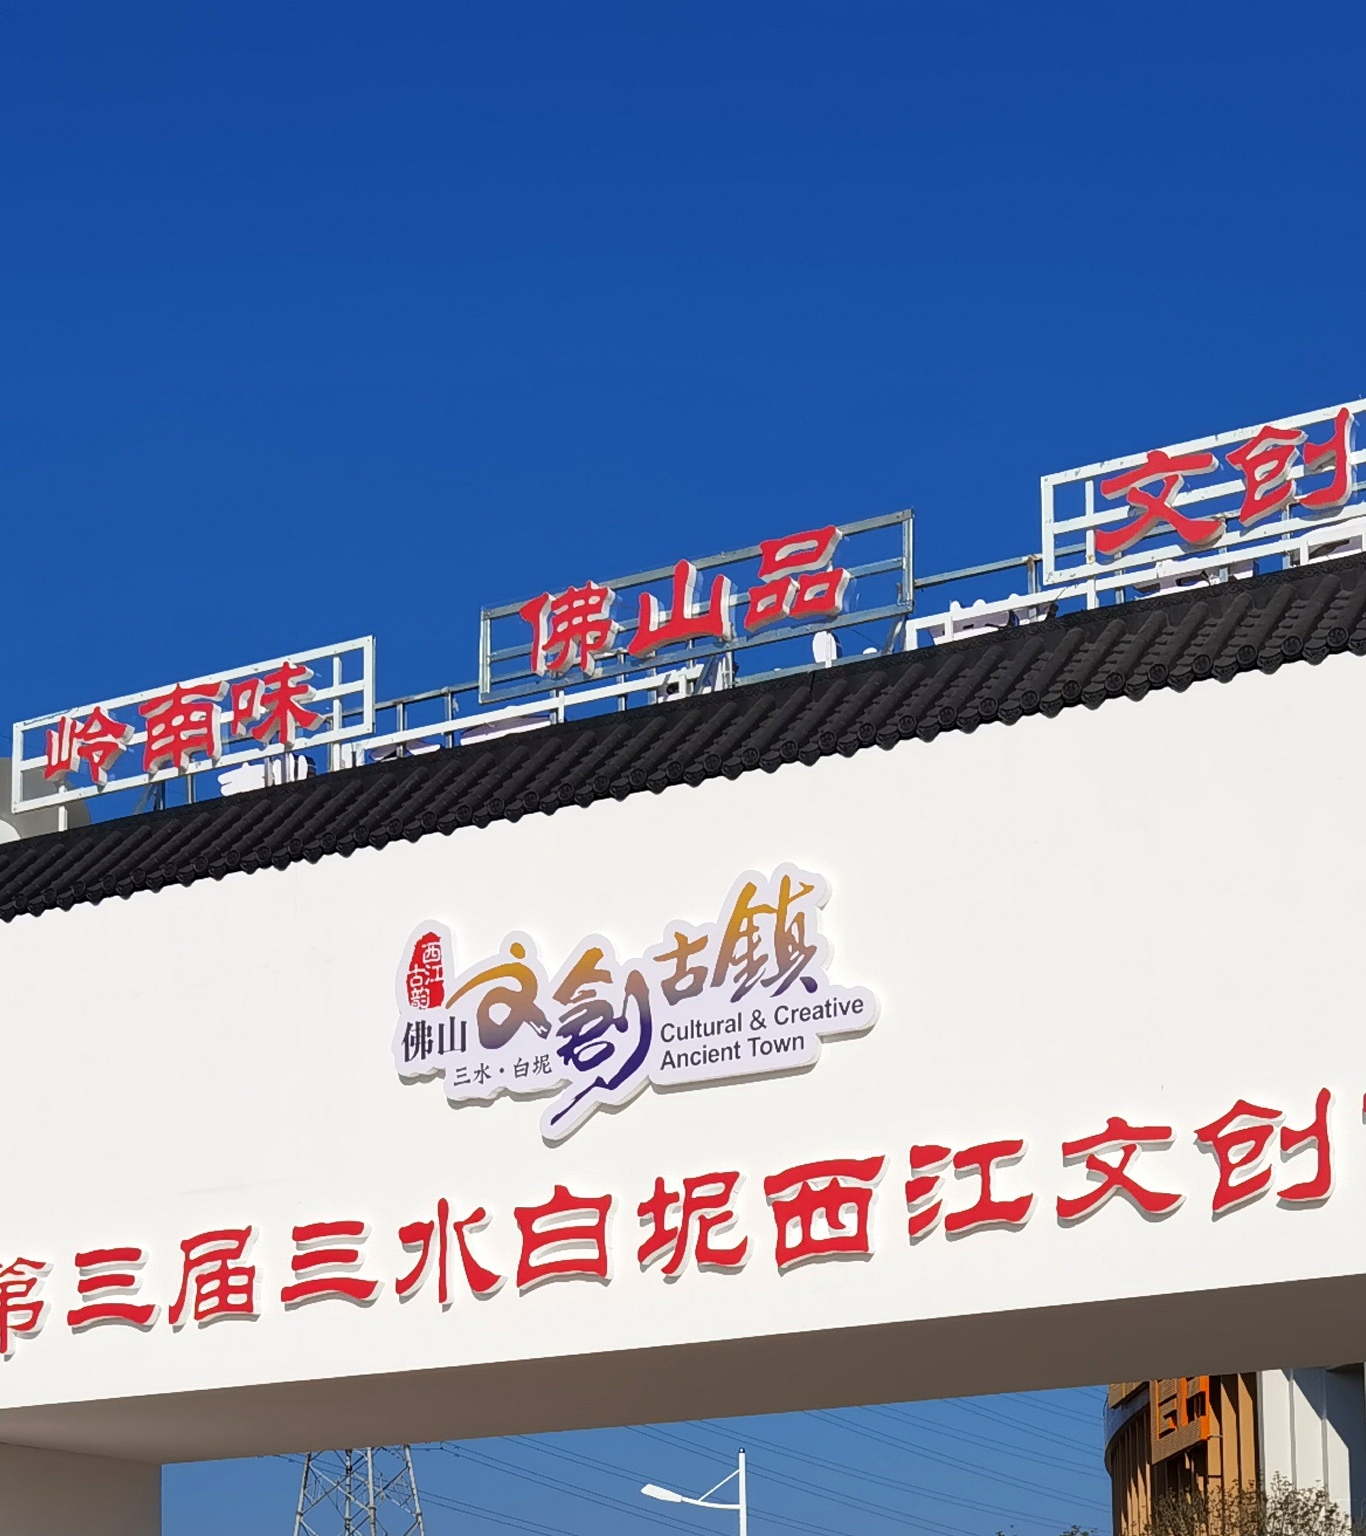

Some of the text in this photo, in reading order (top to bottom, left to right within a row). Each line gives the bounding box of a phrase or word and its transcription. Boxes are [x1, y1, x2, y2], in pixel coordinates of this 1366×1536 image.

[519, 525, 851, 677] 佛山品
[44, 661, 326, 786] 岭南味
[401, 1016, 468, 1063] 佛山
[660, 996, 864, 1044] Cultural & Creative
[660, 1035, 805, 1070] Ancient Town
